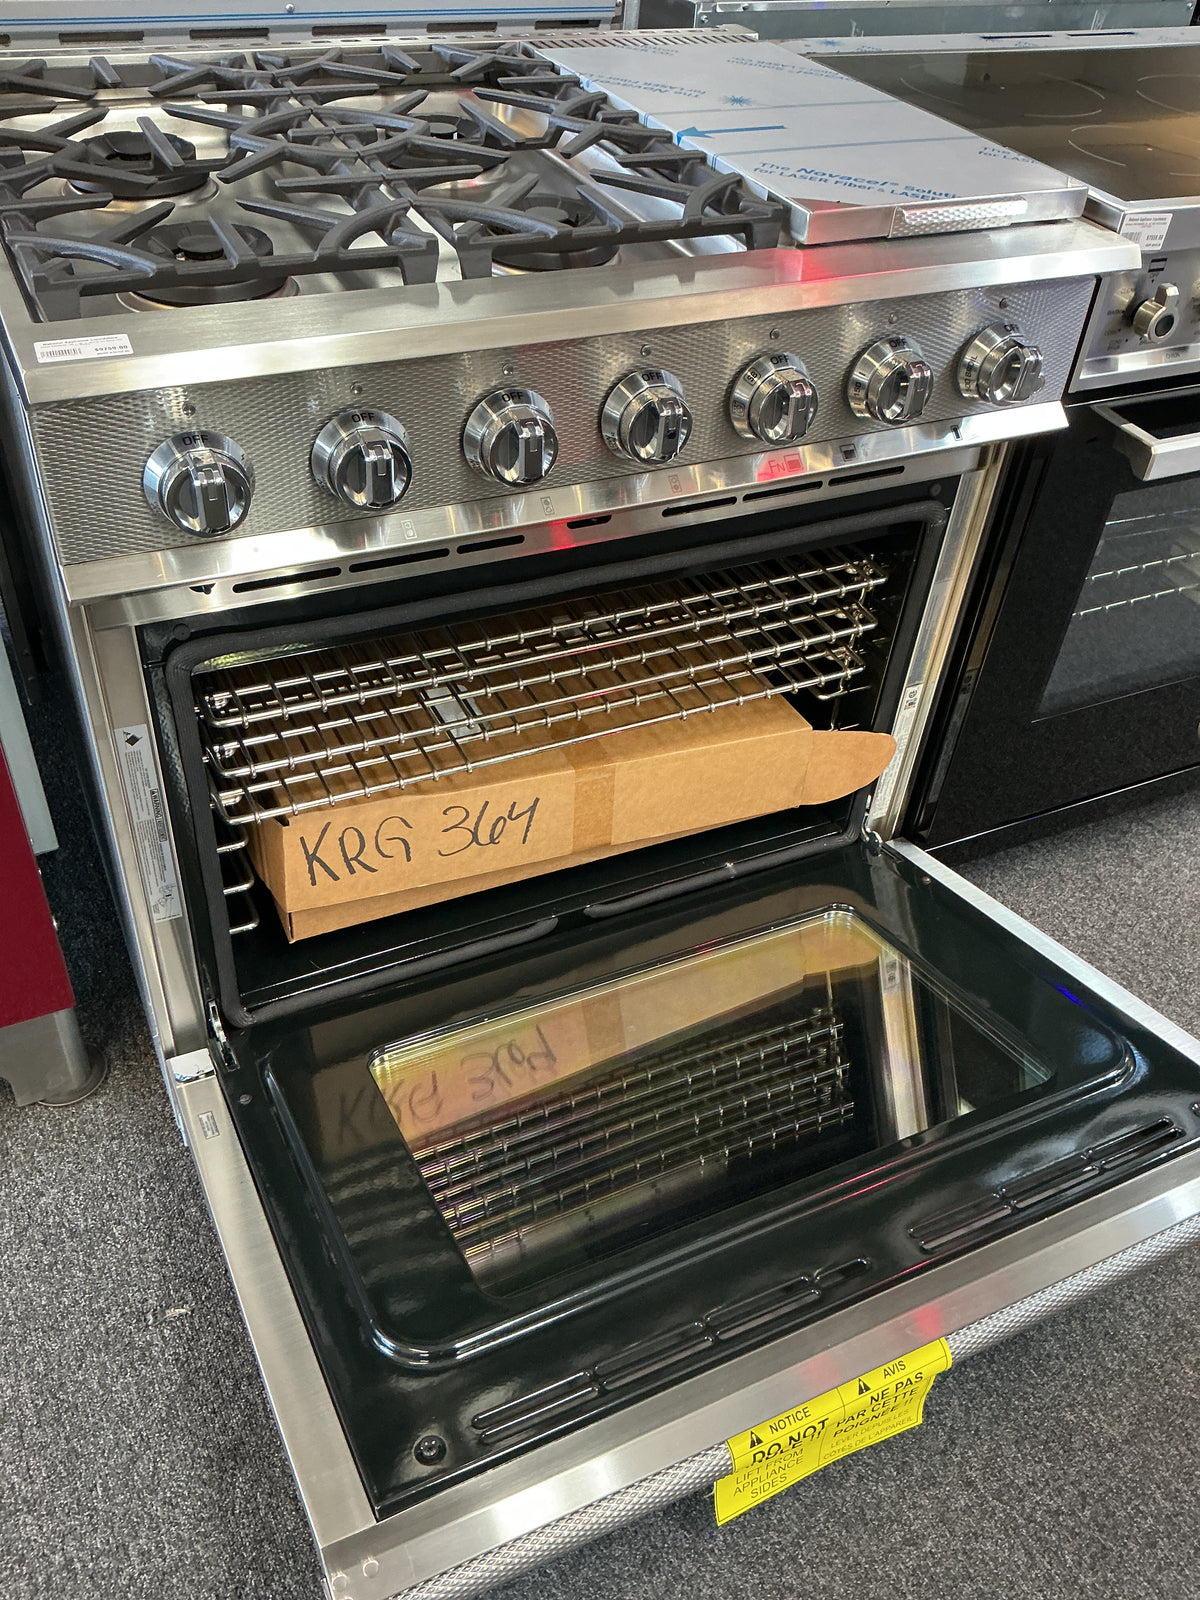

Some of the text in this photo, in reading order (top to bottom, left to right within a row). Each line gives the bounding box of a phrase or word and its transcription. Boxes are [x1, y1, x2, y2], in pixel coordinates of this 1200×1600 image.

[779, 171, 828, 184] LASER
[834, 179, 873, 192] Fiber
[888, 338, 907, 348] OFF
[770, 354, 788, 365] OFF
[641, 371, 663, 382] OFF
[501, 391, 524, 403] OFF
[351, 412, 375, 423] OFF
[182, 434, 209, 446] OFF
[299, 797, 541, 887] KRG 364
[883, 1360, 906, 1379] AVIS
[870, 1371, 924, 1405] NE PAS
[836, 1386, 920, 1428] PAR CETTE
[769, 1406, 812, 1434] NOTICE
[831, 1430, 859, 1448] LEVER
[893, 1408, 910, 1423] LES
[752, 1442, 781, 1464] DO
[788, 1417, 829, 1446] NOT
[855, 1437, 867, 1447] DE
[733, 1457, 804, 1497] APPLIANCE
[736, 1467, 760, 1485] LIFT
[765, 1447, 804, 1470] FROM
[750, 1472, 788, 1499] SIDES
